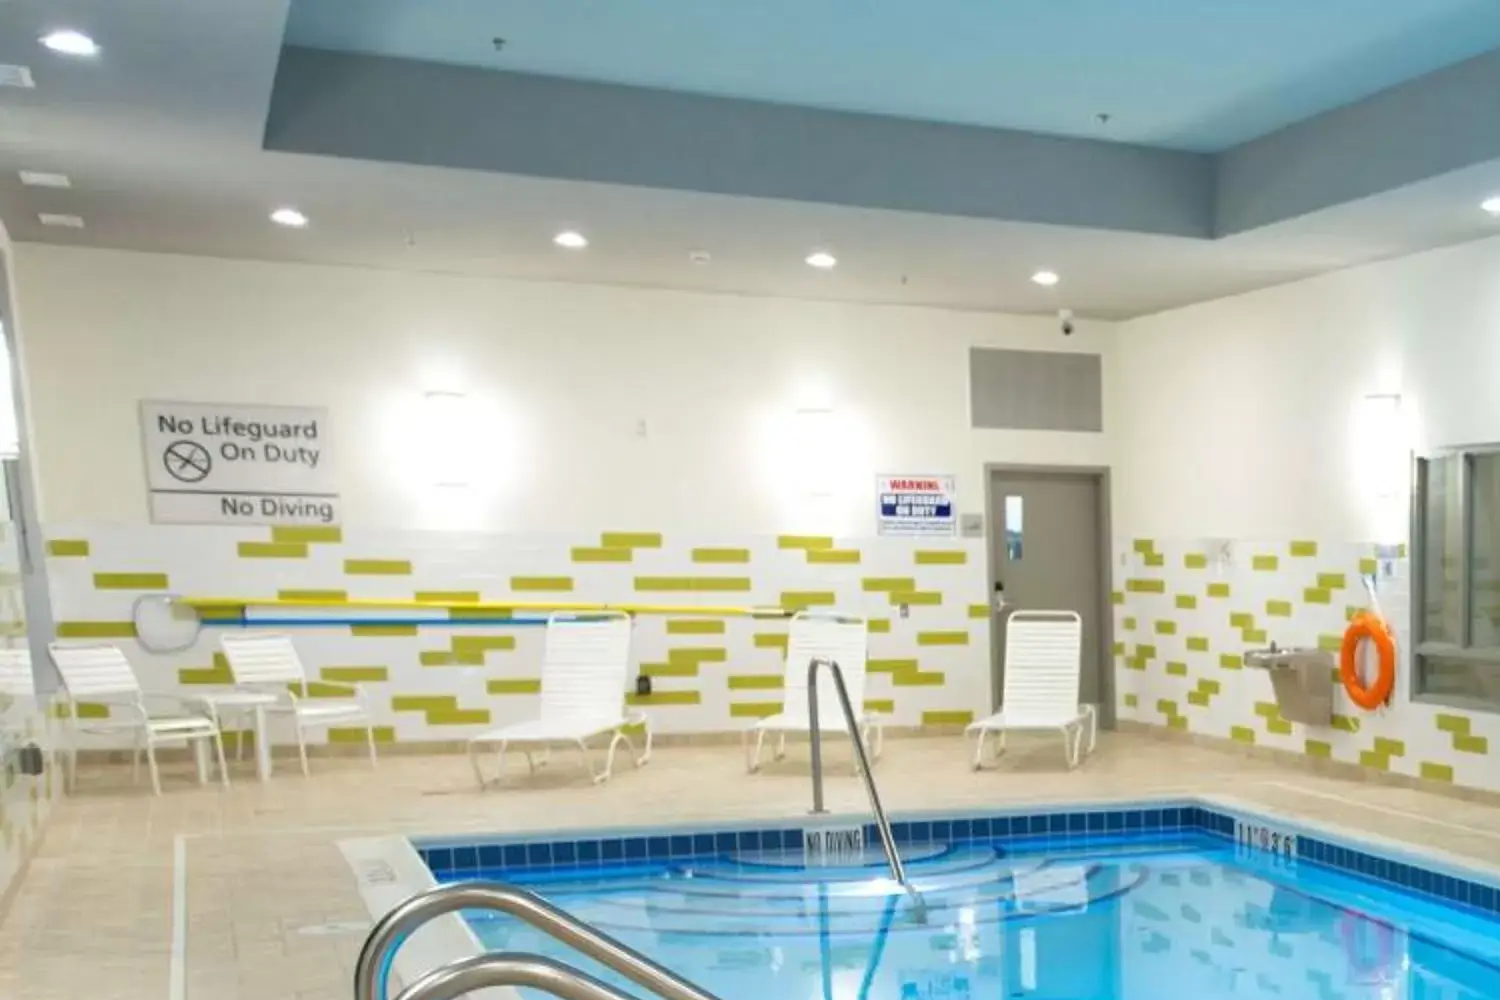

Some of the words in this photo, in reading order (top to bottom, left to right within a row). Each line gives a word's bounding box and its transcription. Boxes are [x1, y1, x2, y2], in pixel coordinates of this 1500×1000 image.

[157, 415, 194, 435] No
[202, 416, 318, 442] Lifeguard
[220, 442, 255, 461] On
[264, 443, 320, 468] Duty
[221, 497, 254, 517] No
[261, 498, 334, 522] Diving
